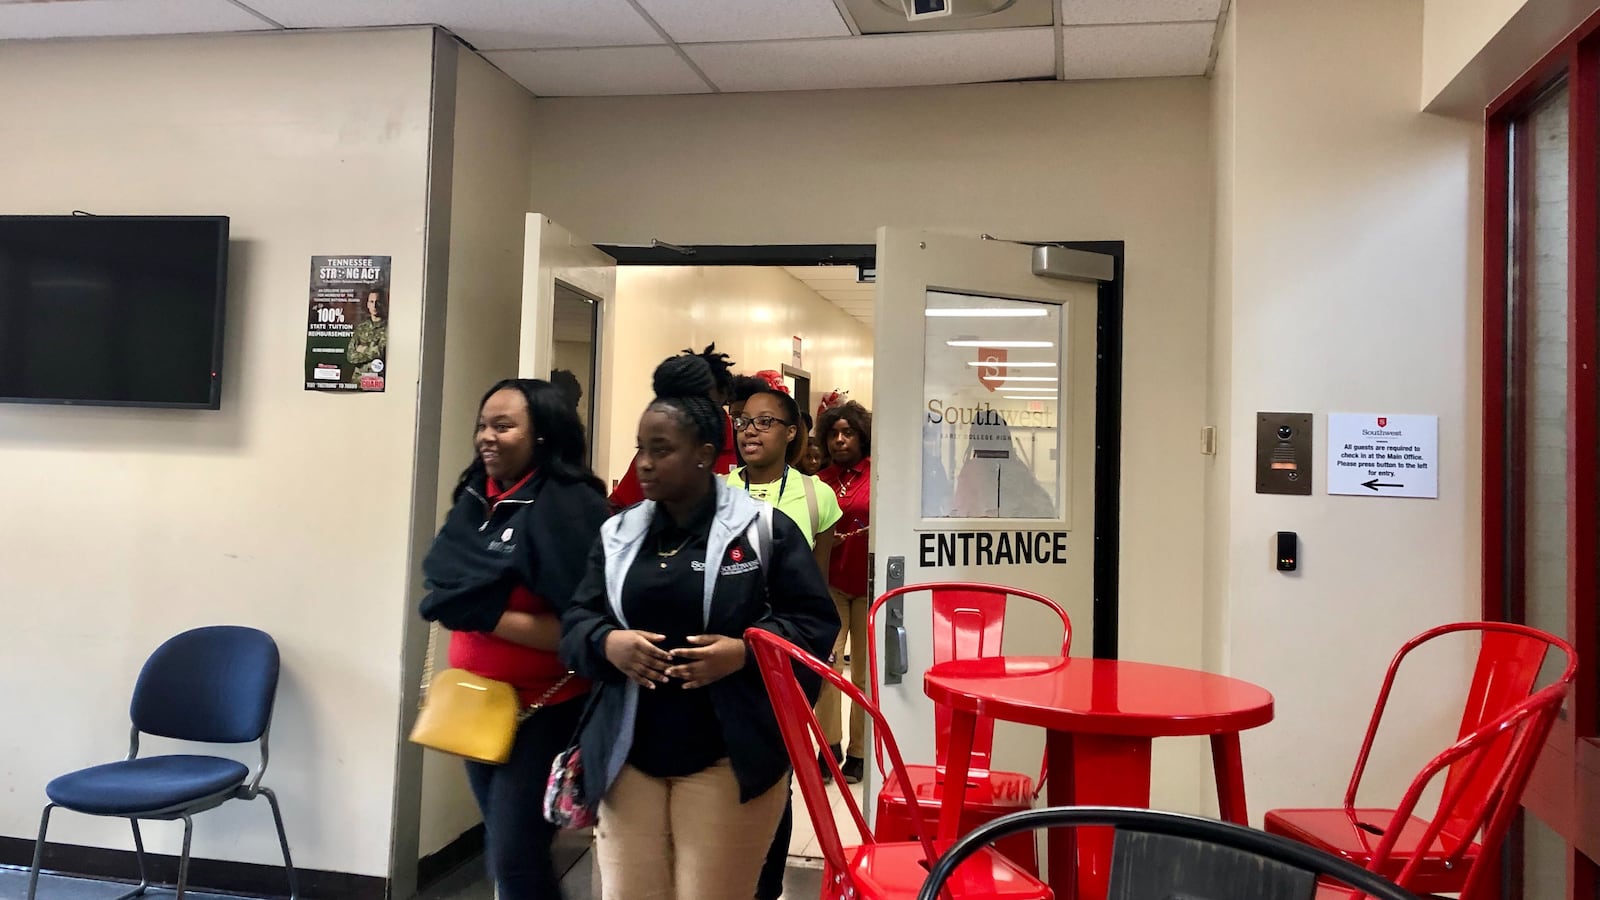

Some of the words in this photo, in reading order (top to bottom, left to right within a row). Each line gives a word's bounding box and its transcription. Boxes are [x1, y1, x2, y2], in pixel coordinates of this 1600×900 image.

[328, 259, 373, 267] TENNESSEE
[361, 268, 380, 279] ACT
[317, 308, 345, 323] 100%
[928, 399, 1053, 427] Southwest
[732, 549, 741, 557] S
[919, 532, 1067, 568] ENTRANCE
